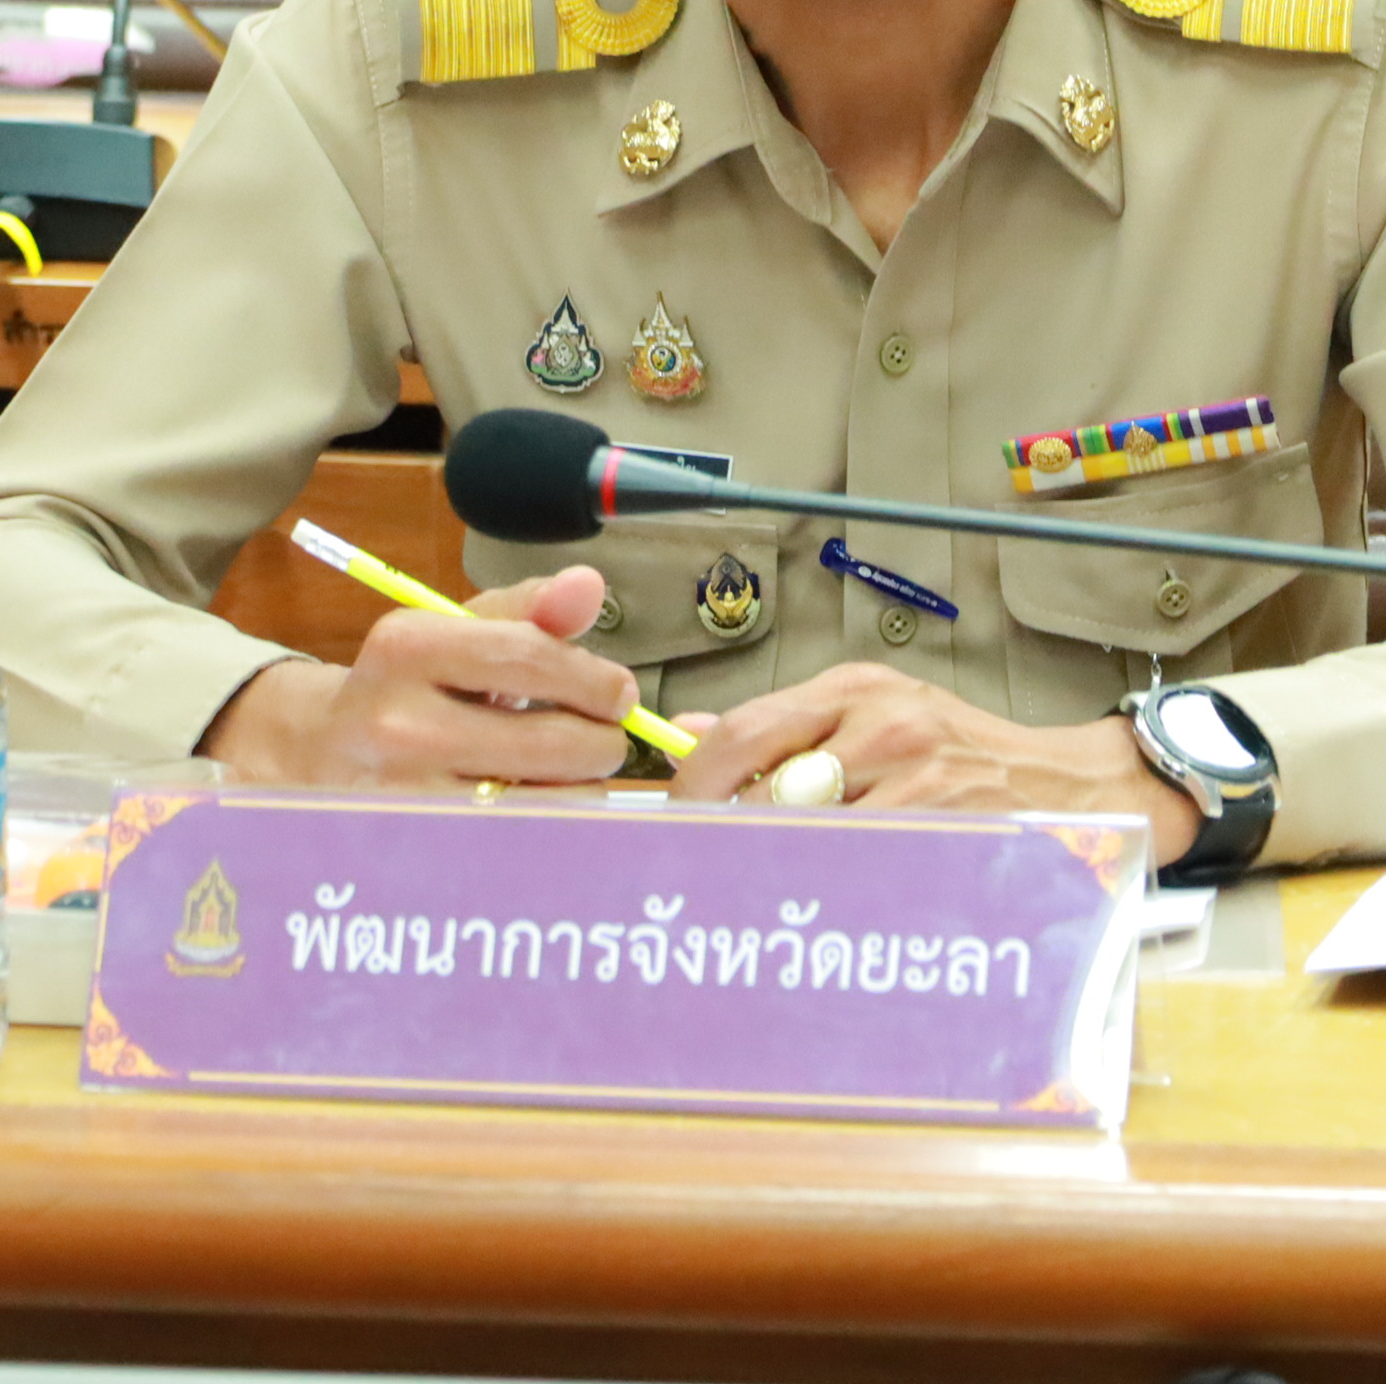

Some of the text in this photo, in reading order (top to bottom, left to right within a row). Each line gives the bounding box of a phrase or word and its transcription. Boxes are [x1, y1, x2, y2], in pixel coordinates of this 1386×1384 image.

[285, 881, 1032, 999] พัฒนาการจังหวัดยะลา
